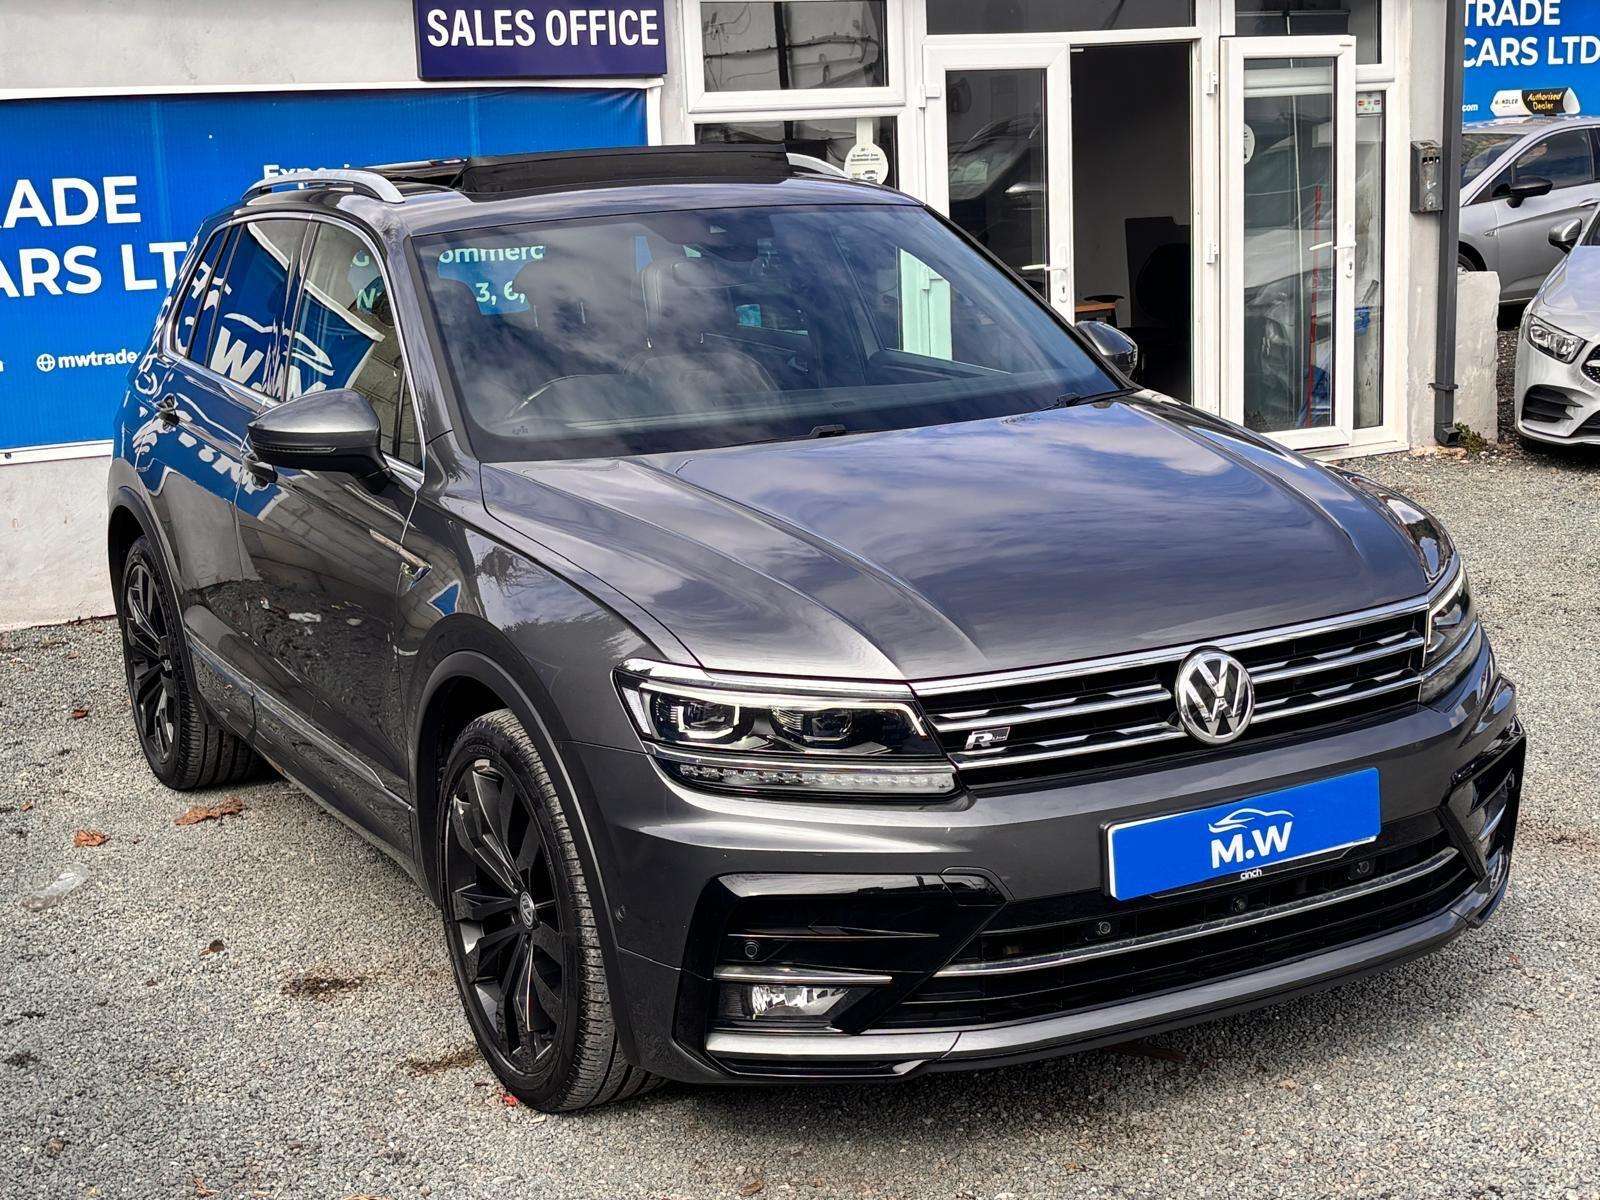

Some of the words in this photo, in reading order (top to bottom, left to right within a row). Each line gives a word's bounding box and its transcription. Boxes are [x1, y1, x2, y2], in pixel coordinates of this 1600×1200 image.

[1464, 0, 1560, 27] TRADE
[427, 9, 536, 47] SALES
[545, 9, 659, 46] OFFICE
[1463, 37, 1538, 67] CARS
[1547, 35, 1600, 65] LTD
[1527, 91, 1563, 102] Authorised
[1533, 101, 1554, 111] Dealer
[0, 176, 142, 229] ADE
[476, 282, 497, 306] 3,
[1210, 821, 1292, 869] M.W
[1240, 868, 1263, 880] cinch
